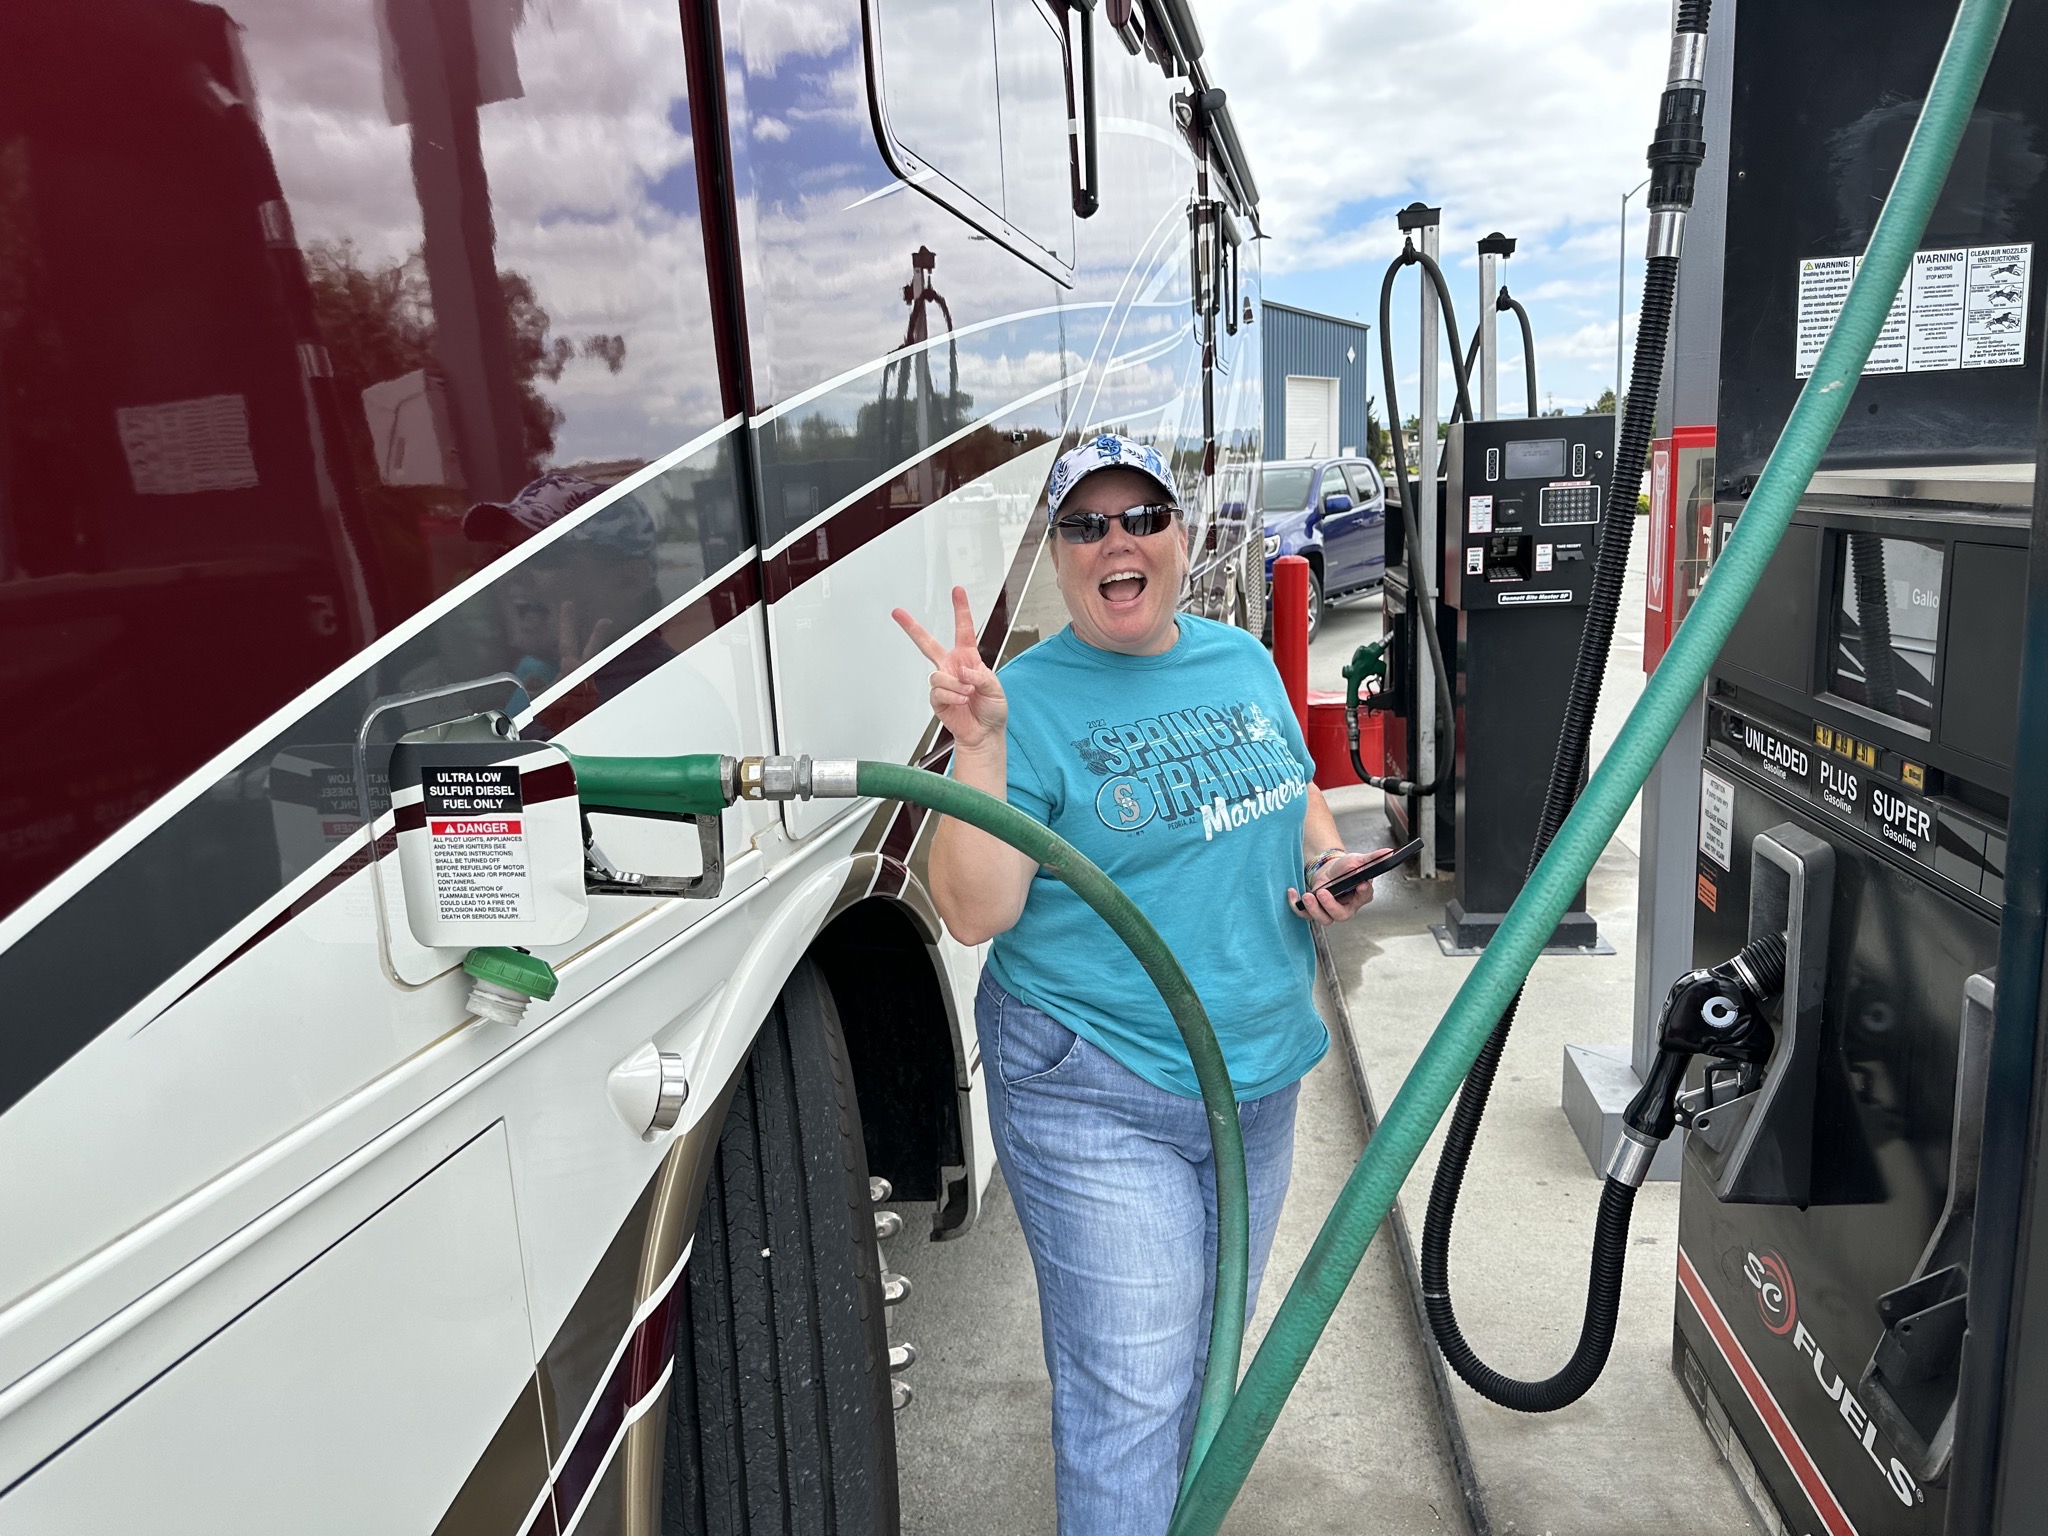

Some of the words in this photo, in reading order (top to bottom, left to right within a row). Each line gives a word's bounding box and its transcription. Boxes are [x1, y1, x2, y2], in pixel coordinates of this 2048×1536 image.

[1815, 261, 1850, 269] WARNING:
[1917, 252, 1963, 264] WARNING
[1978, 255, 2020, 263] INSTRUCTIONS
[1087, 719, 1107, 729] 2023
[1092, 705, 1236, 774] SPRING
[1745, 726, 1808, 776] UNLEADED
[437, 773, 474, 782] ULTRA
[475, 773, 501, 782] LOW
[1763, 759, 1786, 780] Gasoline
[430, 786, 473, 795] SULFUR
[475, 786, 515, 795] DIESEL
[1820, 761, 1858, 801] PLUS
[443, 799, 471, 808] FUEL
[473, 799, 504, 808] ONLY
[1200, 775, 1306, 841] Mariners
[1824, 789, 1852, 814] Gasoline
[1873, 790, 1931, 842] SUPER
[457, 823, 508, 833] DANGER
[1883, 823, 1917, 851] Gasoline
[1744, 1252, 1782, 1312] SC
[1793, 1320, 1917, 1507] FUELS
